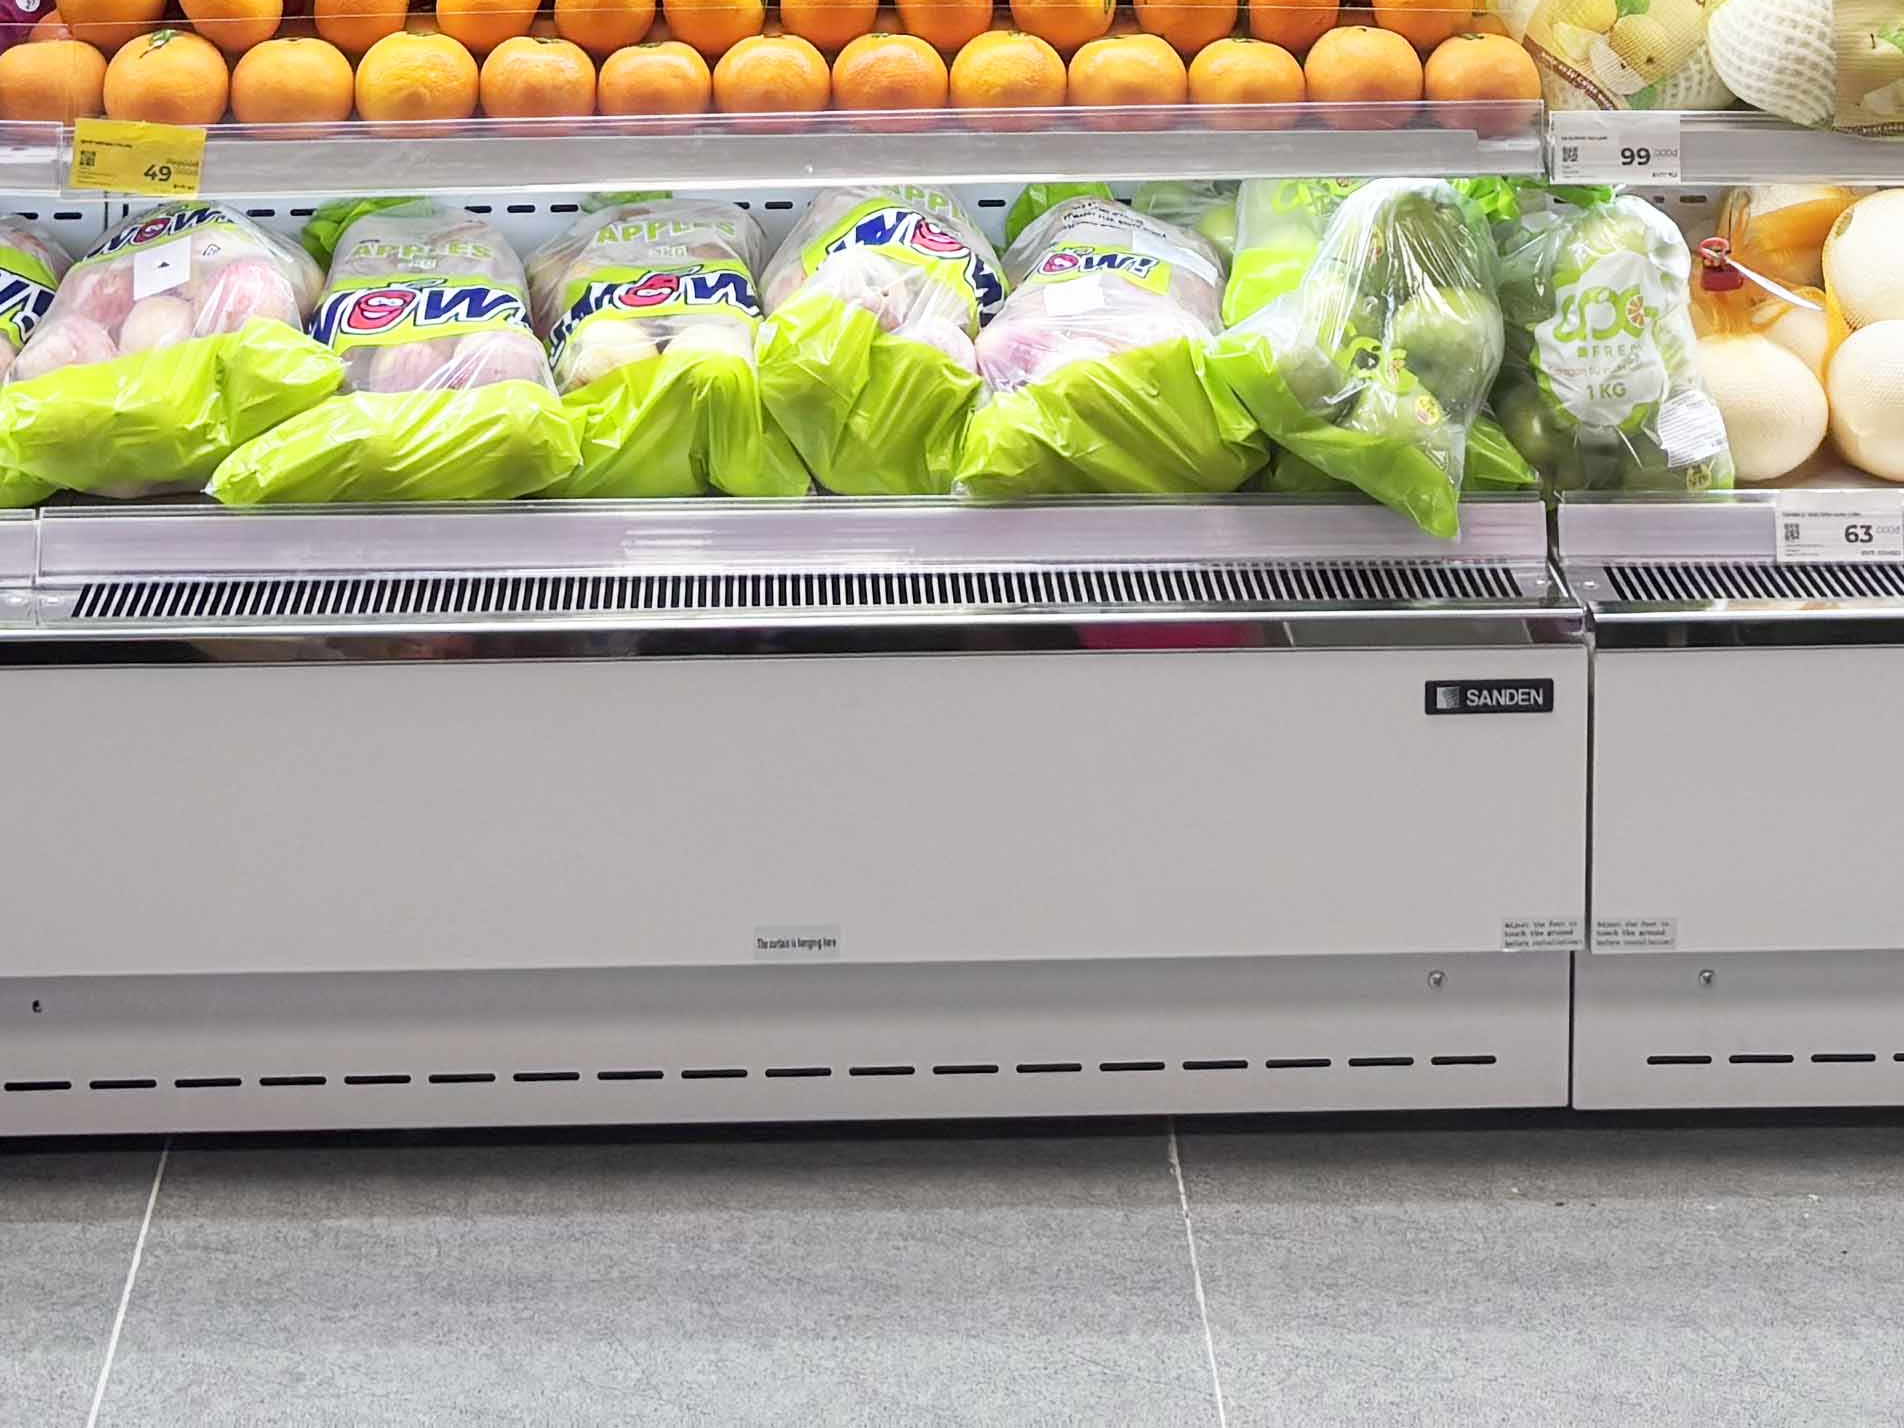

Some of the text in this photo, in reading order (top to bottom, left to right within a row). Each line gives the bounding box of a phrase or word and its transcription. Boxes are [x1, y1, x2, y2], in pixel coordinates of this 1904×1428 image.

[1620, 147, 1651, 166] 99
[143, 163, 171, 182] 49
[1844, 523, 1874, 543] 63
[1466, 687, 1543, 707] SANDEN
